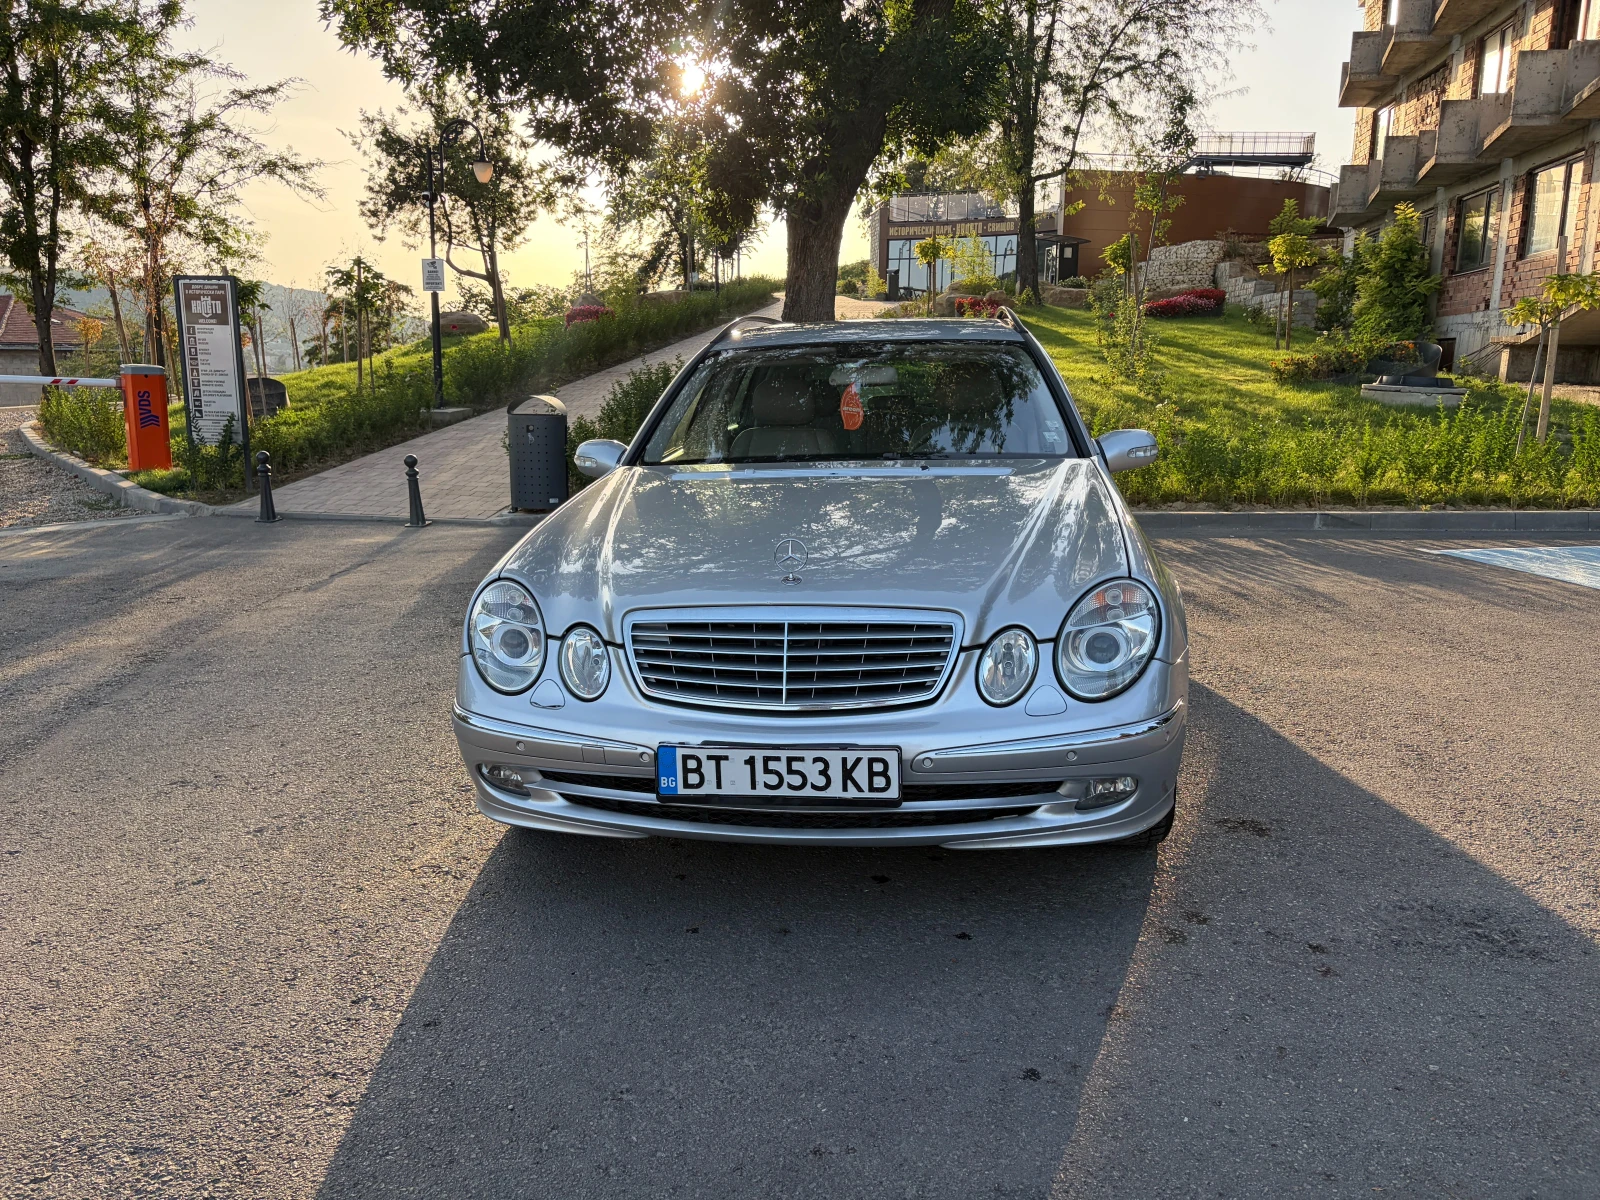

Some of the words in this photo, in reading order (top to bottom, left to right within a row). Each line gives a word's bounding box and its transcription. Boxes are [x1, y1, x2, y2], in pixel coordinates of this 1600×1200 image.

[889, 226, 934, 236] ИСТОРИЧЕСКИ
[936, 225, 952, 234] ПАРК
[988, 222, 1014, 232] СВИЩОВ
[191, 300, 222, 315] КАЛЕТО
[138, 391, 151, 416] VDS
[681, 754, 729, 790] BT
[744, 755, 832, 791] 1553
[841, 756, 891, 793] KB
[660, 777, 676, 788] BG
